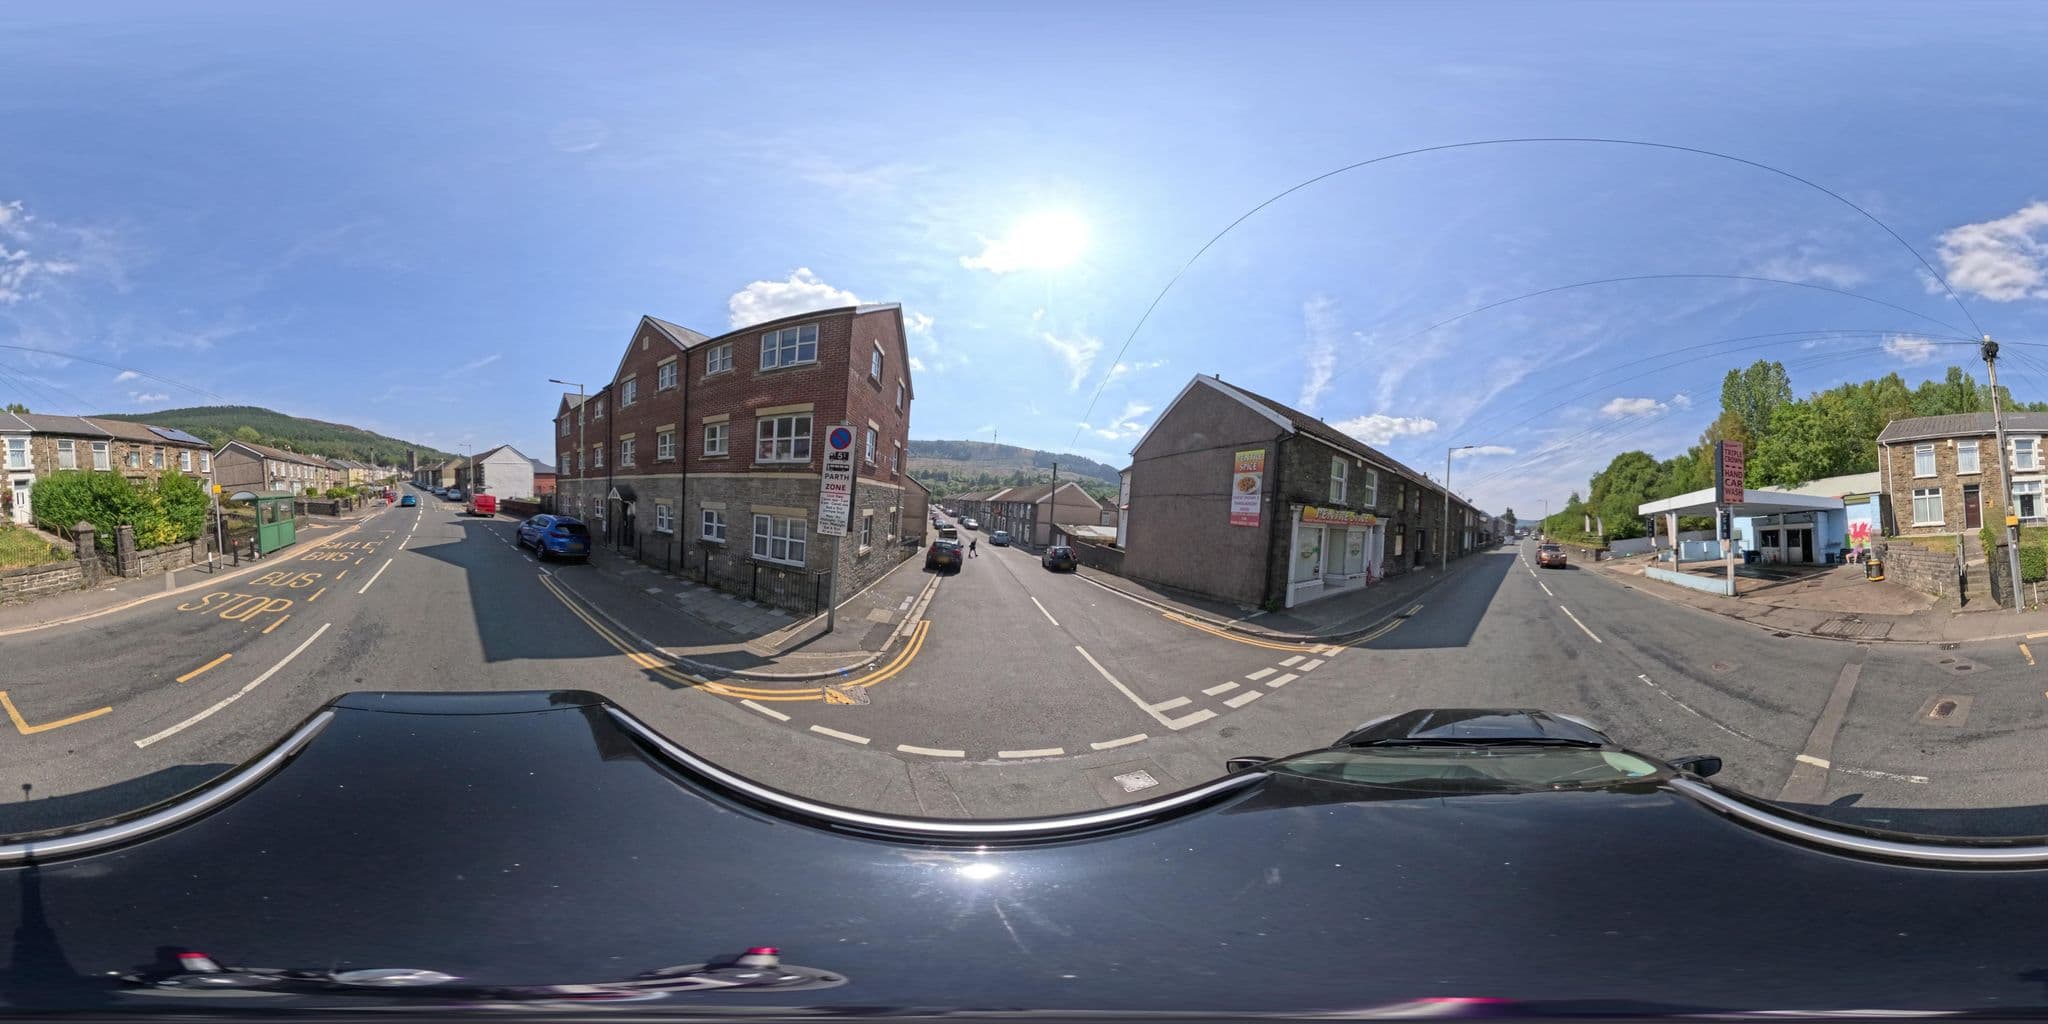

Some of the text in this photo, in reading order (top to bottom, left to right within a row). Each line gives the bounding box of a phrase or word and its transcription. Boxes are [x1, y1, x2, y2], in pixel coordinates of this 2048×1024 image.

[1725, 449, 1742, 458] TRIPLE
[1725, 470, 1742, 479] HAND
[1725, 479, 1742, 487] CAR
[1725, 488, 1742, 496] WASH
[249, 571, 322, 587] BUS
[177, 592, 294, 622] STOP
